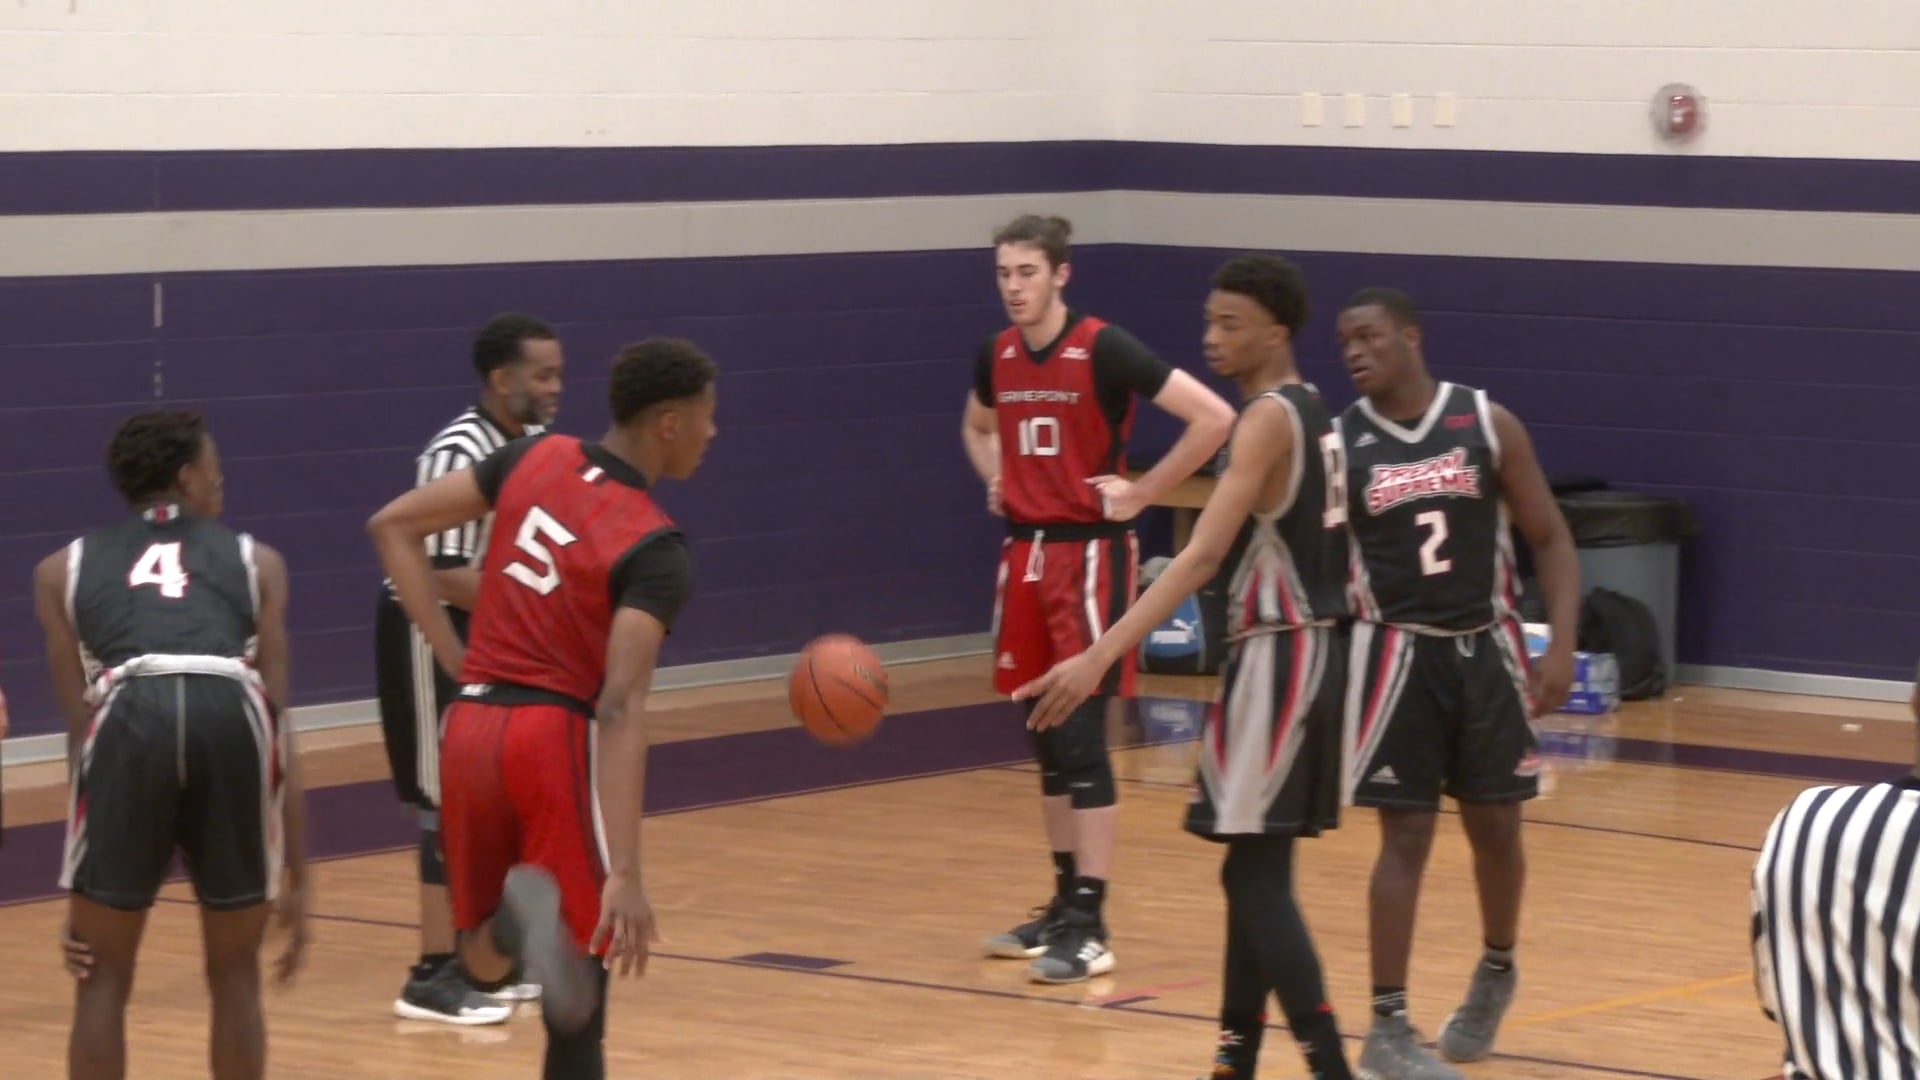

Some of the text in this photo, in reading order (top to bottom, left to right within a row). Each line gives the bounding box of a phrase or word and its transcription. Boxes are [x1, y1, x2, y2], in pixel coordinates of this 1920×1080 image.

[1018, 416, 1060, 456] 10
[1363, 465, 1483, 516] SUPREME
[1369, 447, 1467, 488] DREAM
[127, 540, 190, 600] 4
[502, 505, 579, 596] 5
[1414, 510, 1451, 576] 2
